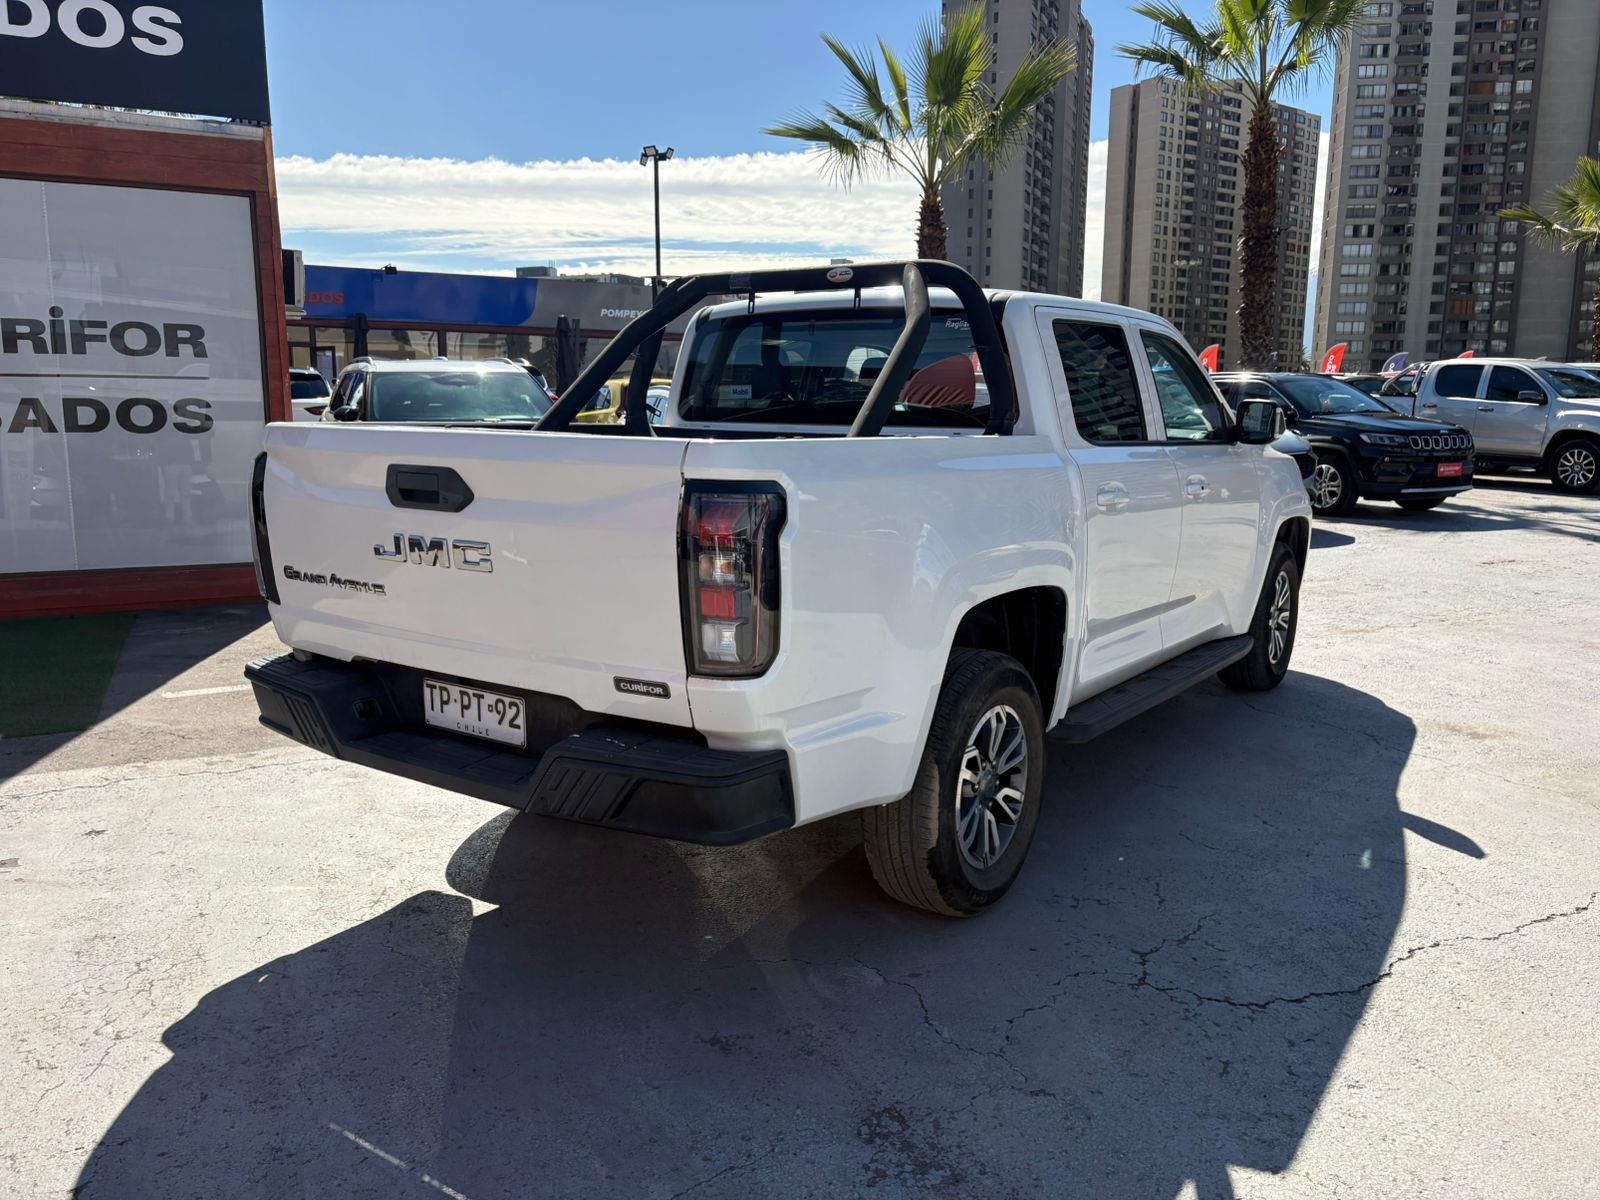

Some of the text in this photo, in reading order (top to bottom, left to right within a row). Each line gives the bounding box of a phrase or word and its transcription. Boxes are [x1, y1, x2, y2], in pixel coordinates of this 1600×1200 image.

[304, 291, 345, 304] DOS
[600, 308, 648, 319] POMPEY
[0, 397, 214, 434] ADOS
[373, 533, 494, 573] JMC
[456, 722, 490, 737] CHILE
